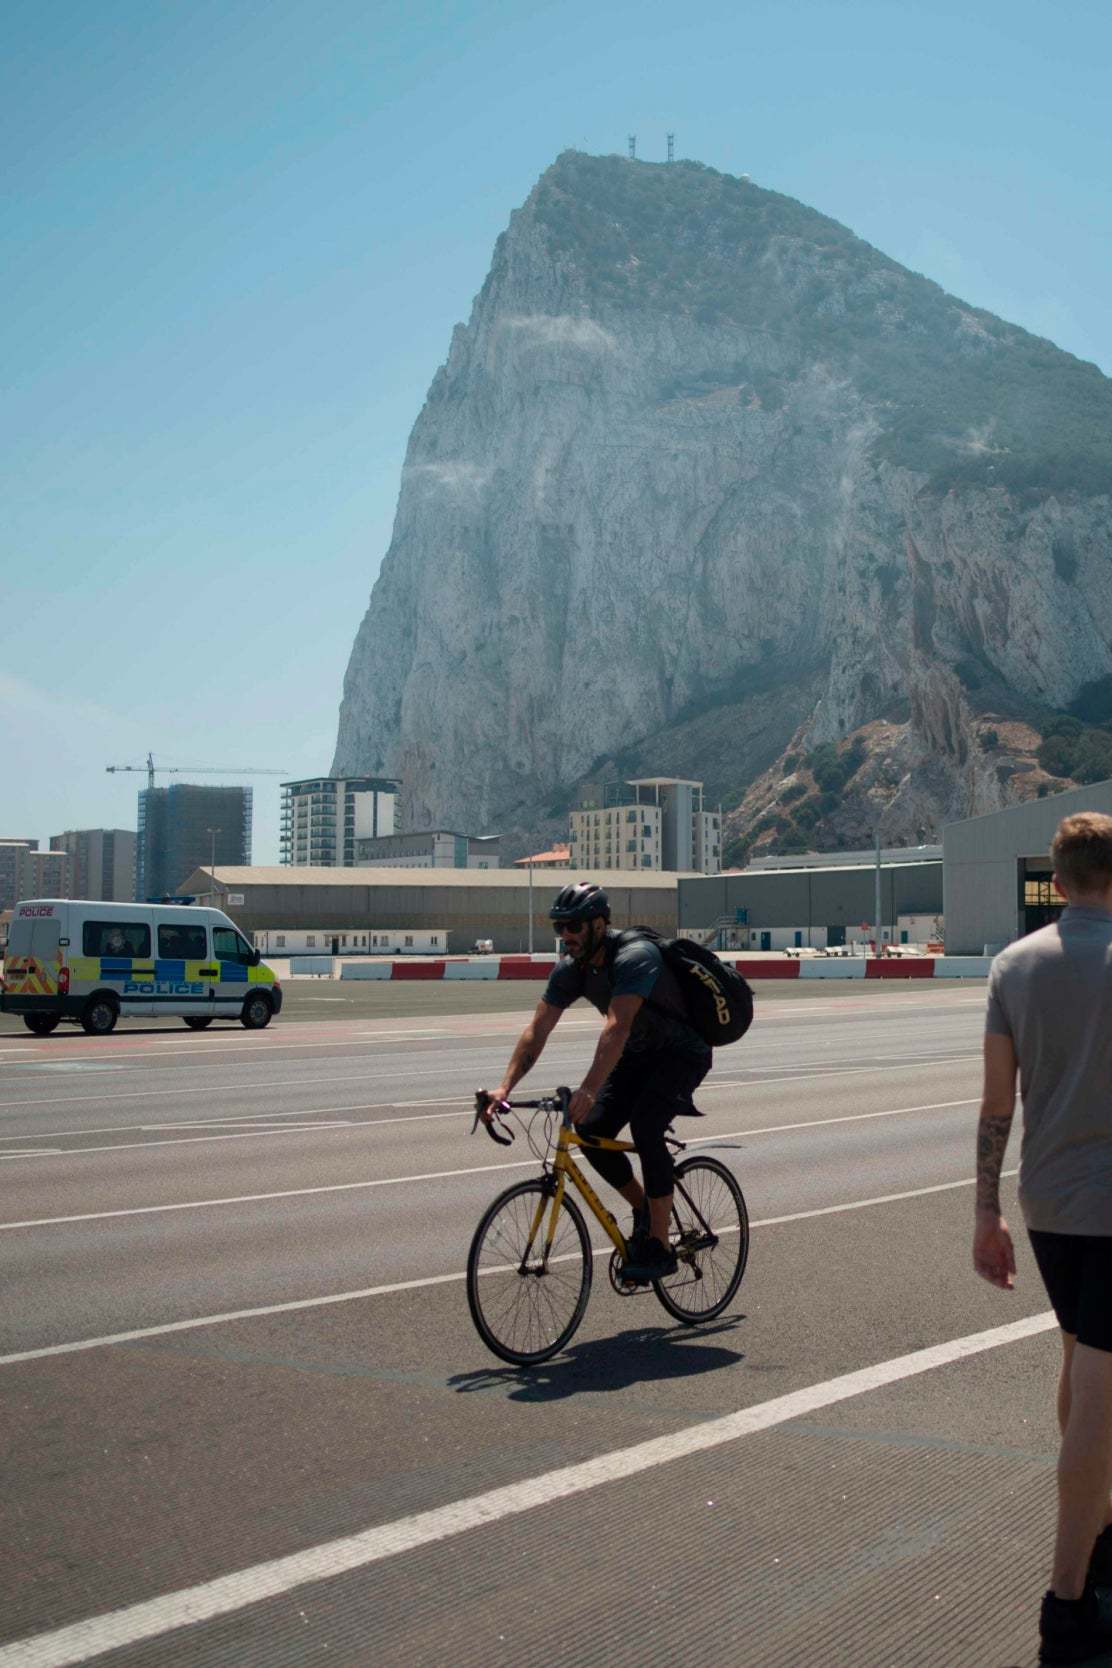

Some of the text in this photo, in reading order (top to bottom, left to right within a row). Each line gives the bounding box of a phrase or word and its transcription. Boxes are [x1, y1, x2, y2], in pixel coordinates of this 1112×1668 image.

[19, 905, 54, 917] POLICE
[124, 983, 204, 994] POLICE
[688, 964, 731, 1025] HEAD
